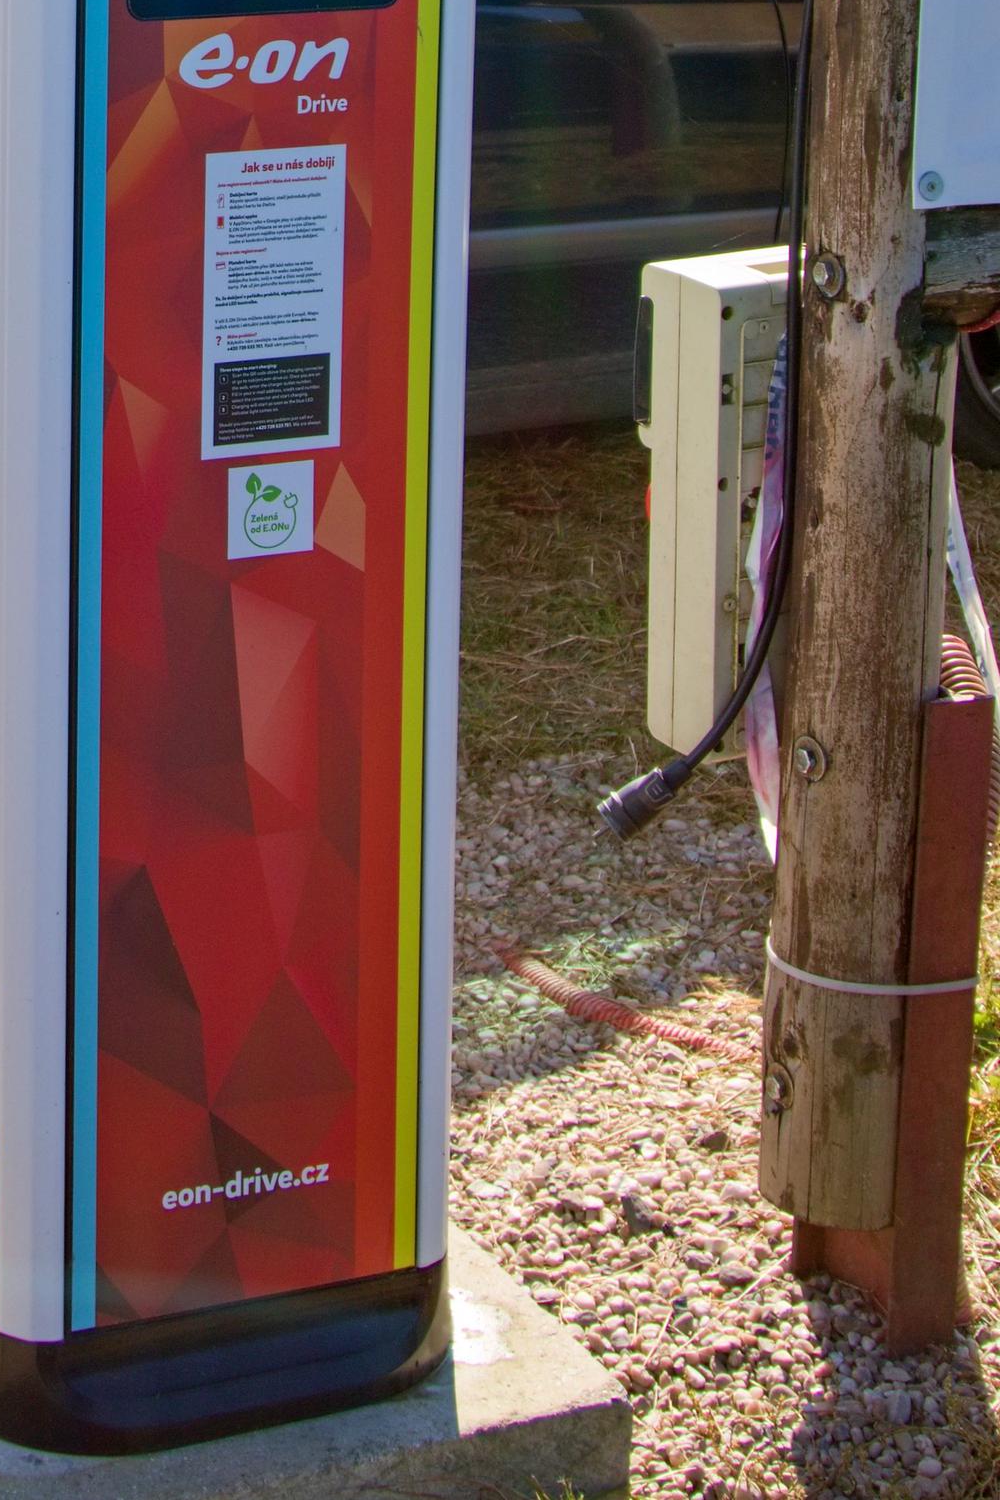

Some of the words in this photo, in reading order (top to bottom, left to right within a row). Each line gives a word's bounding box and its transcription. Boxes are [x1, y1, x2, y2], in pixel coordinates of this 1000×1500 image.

[297, 93, 348, 115] Drive
[241, 161, 260, 174] Jak
[262, 163, 274, 173] se
[276, 163, 283, 171] u
[285, 158, 304, 171] nás
[250, 512, 279, 523] Zelená
[250, 524, 261, 534] od
[161, 1163, 330, 1210] eon-drive.cz
